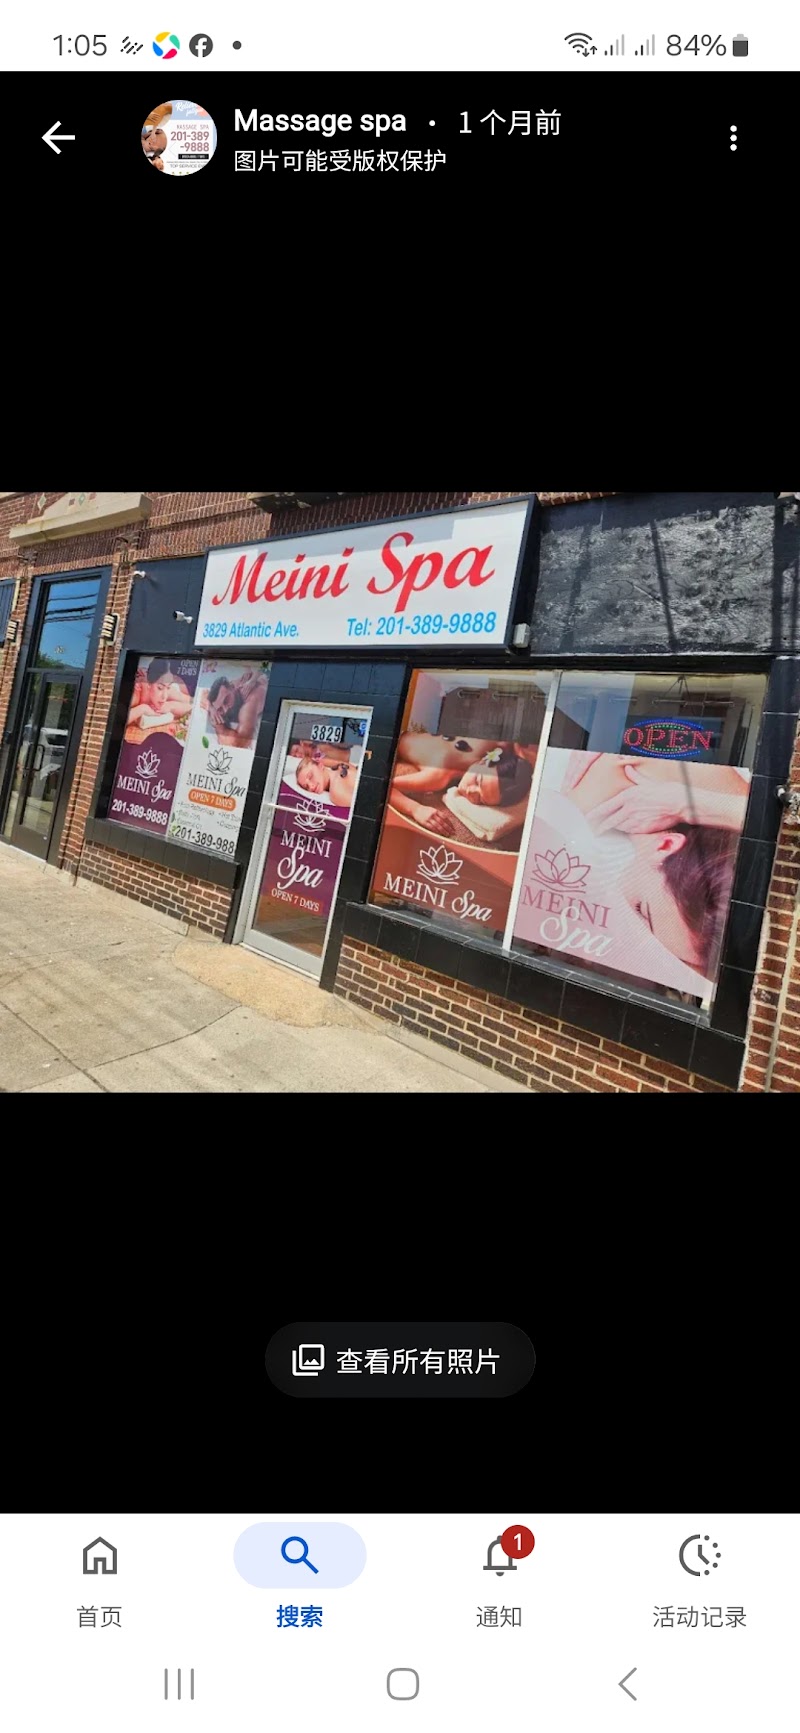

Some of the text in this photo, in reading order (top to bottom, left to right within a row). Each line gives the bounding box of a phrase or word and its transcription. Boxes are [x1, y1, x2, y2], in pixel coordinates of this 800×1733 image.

[53, 34, 107, 56] 1:05
[667, 34, 727, 56] 84%
[235, 109, 407, 137] Massage spa
[480, 109, 562, 136] 个月前
[170, 131, 210, 141] 201-389
[180, 142, 210, 152] -9888
[234, 148, 447, 172] 图片可能受版权保护
[211, 531, 495, 614] Meini Spa
[202, 620, 299, 638] 3829 Atlantic Ave.
[347, 611, 497, 637] Tel: 201-389-9888
[311, 725, 342, 742] 3829
[623, 727, 714, 753] OPEN
[116, 775, 172, 803] MEINI Spa
[186, 772, 246, 799] MEINI Spa
[111, 799, 168, 826] 201-389-9888
[192, 790, 209, 803] OPEN
[210, 795, 216, 804] 7
[215, 797, 233, 809] DAYS
[175, 825, 235, 854] 201-389-988
[280, 830, 333, 858] MEINI
[277, 845, 323, 890] Spa
[271, 888, 320, 912] OPEN 7 DAYS
[383, 872, 492, 923] MEINI Spa
[522, 885, 610, 929] MEINI
[540, 906, 613, 957] Spa
[336, 1347, 501, 1375] 查看所有照片
[512, 1532, 523, 1551] 1
[76, 1605, 122, 1629] 首页
[276, 1604, 323, 1628] 搜索
[476, 1605, 522, 1628] 通知
[653, 1605, 747, 1629] 活动记录
